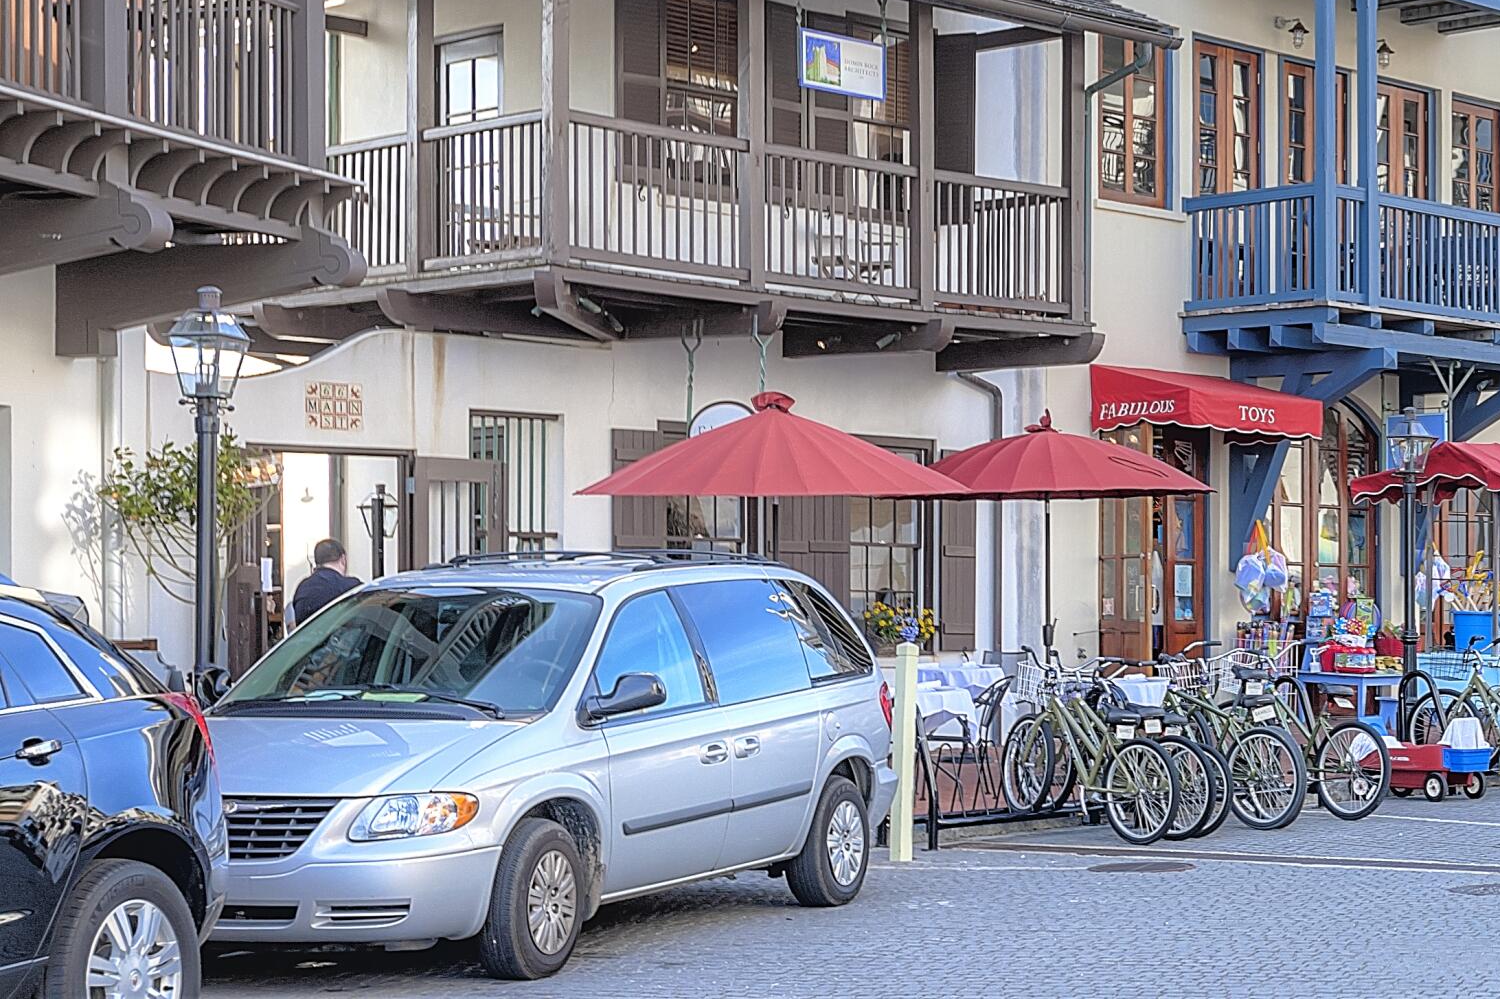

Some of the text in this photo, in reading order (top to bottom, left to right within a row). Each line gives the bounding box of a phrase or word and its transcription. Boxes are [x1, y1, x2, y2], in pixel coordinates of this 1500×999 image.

[307, 399, 360, 416] MAIN
[1100, 399, 1175, 420] FABULOUS
[1238, 405, 1275, 424] TOYS
